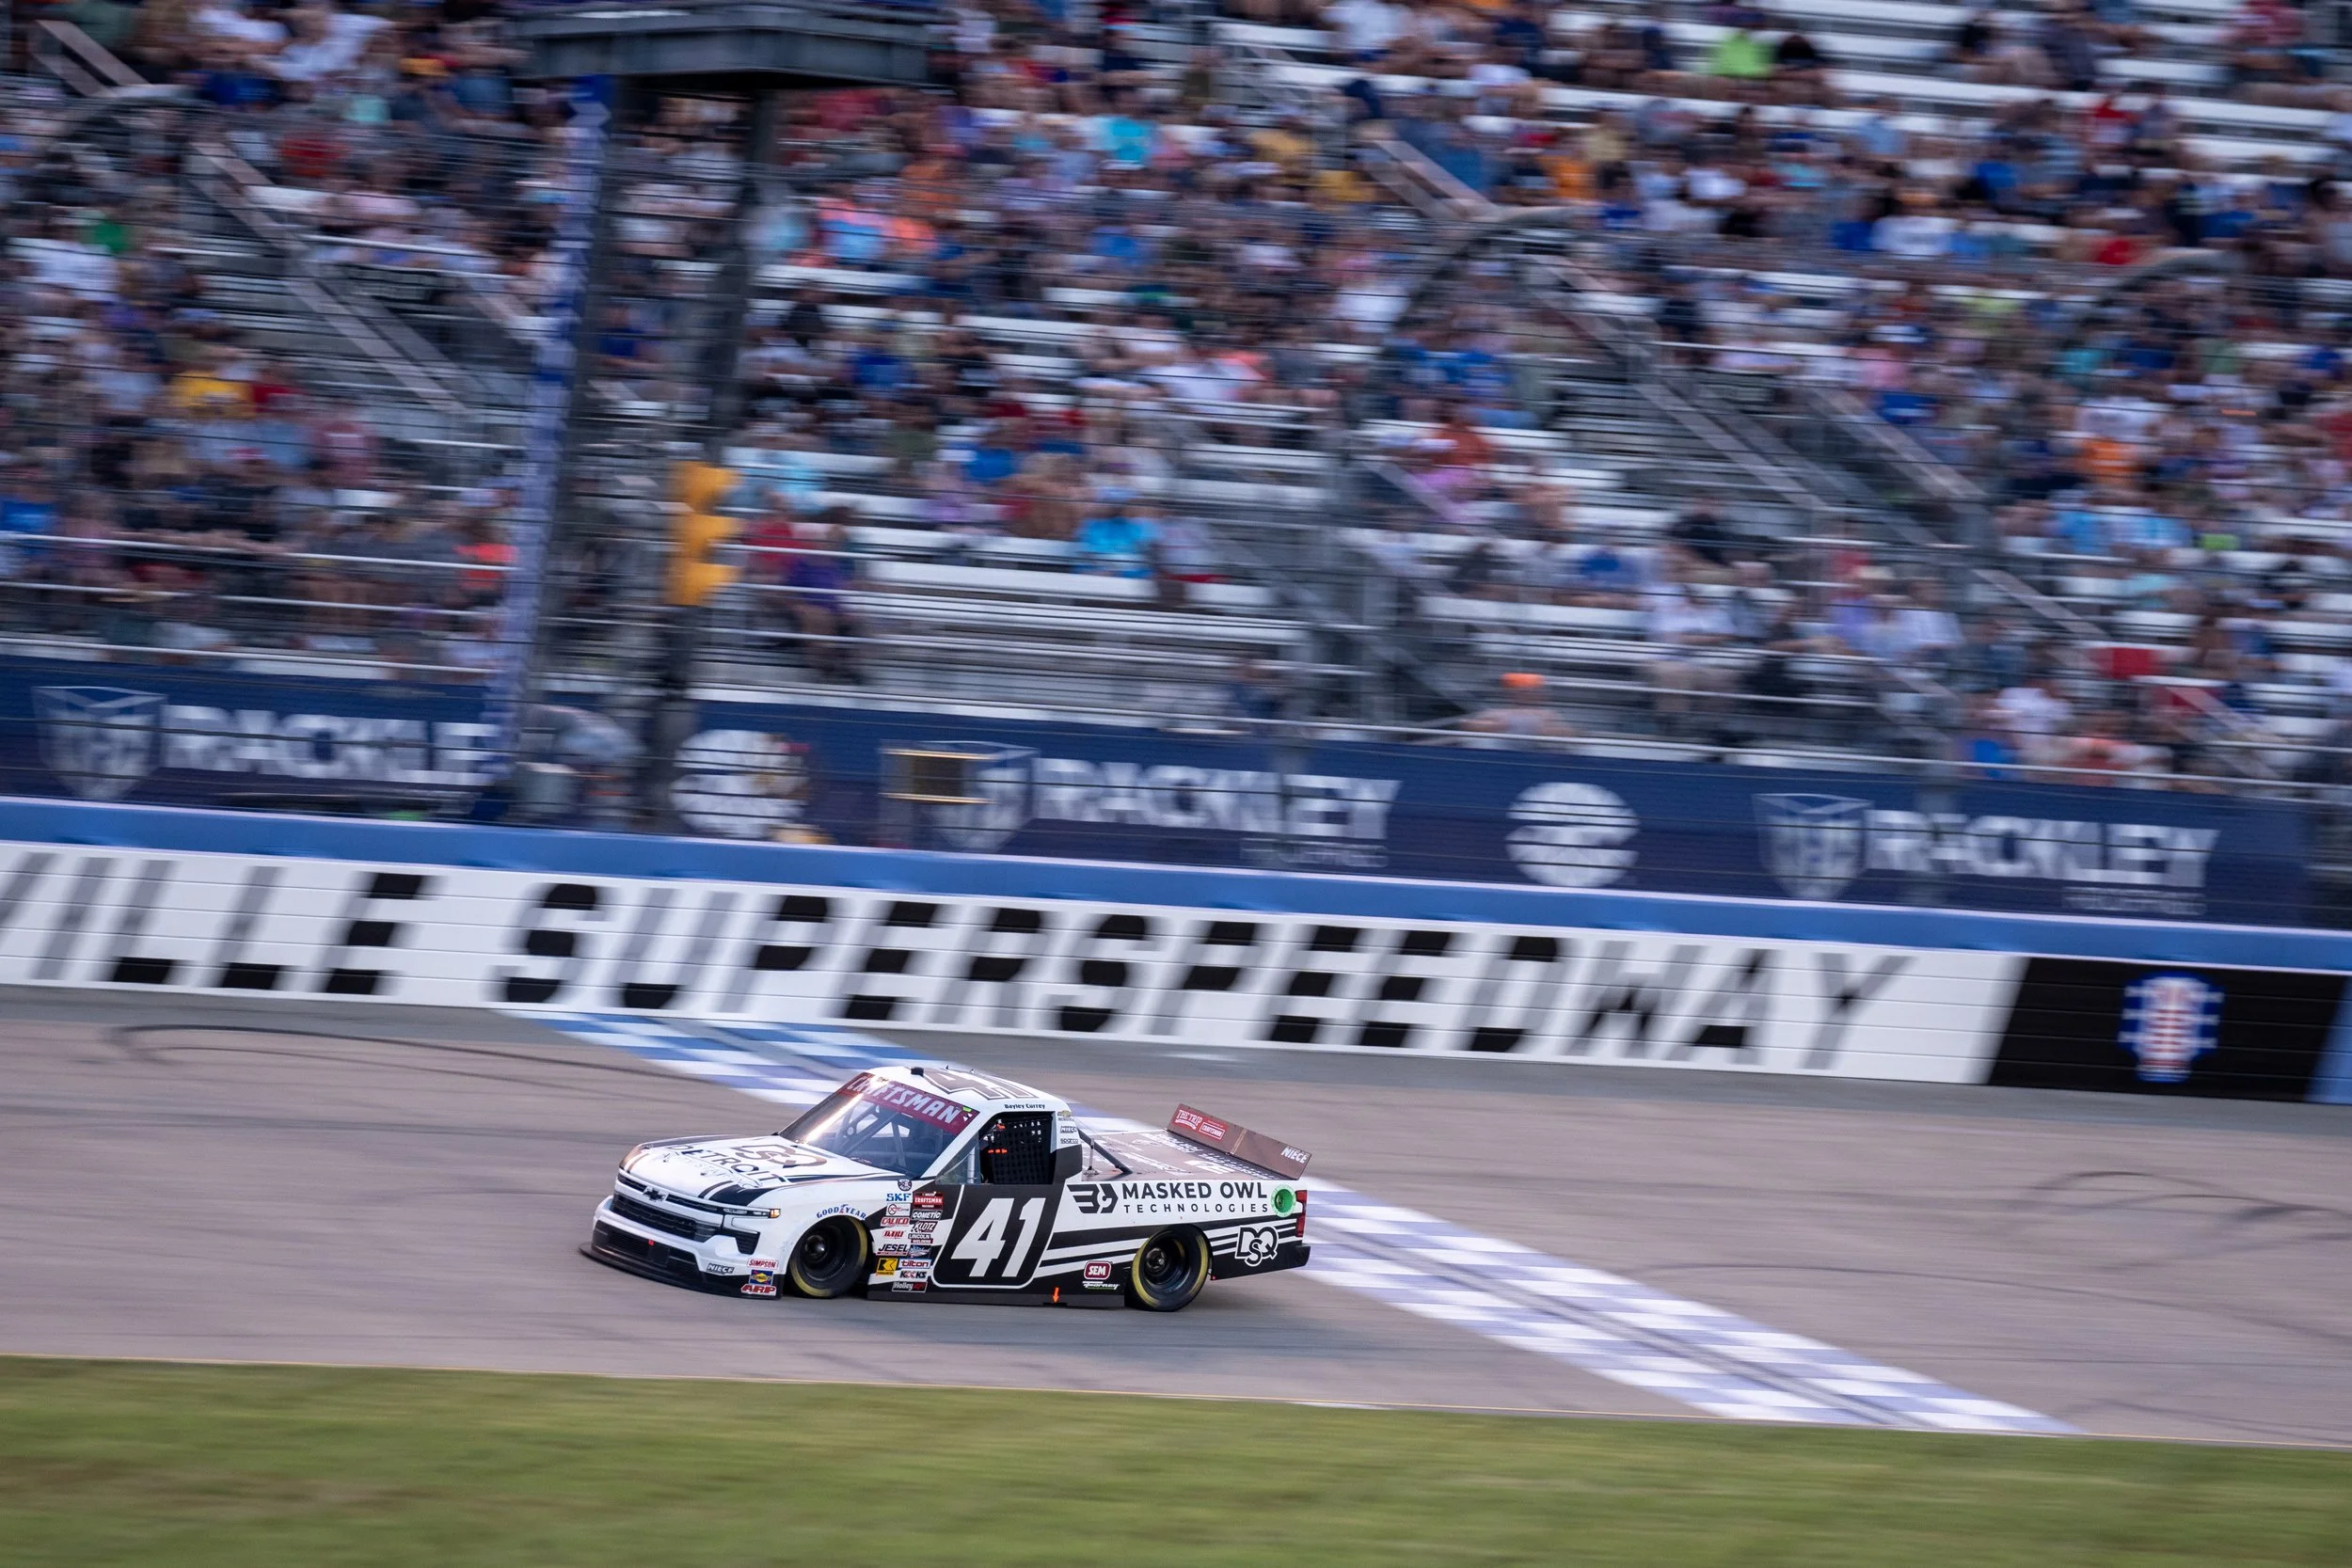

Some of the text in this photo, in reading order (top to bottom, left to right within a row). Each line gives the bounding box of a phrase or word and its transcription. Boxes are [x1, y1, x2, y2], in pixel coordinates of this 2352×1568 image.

[1037, 756, 1400, 840] RACKLEY
[1867, 808, 2220, 888] RACKLEY
[487, 882, 1914, 1070] SUPERSPEEDWAY
[847, 1072, 961, 1123] CRAFTSMAN
[1176, 1109, 1190, 1120] THE
[1188, 1113, 1203, 1126] TRIP
[665, 1145, 786, 1183] DETROIT
[1280, 1147, 1309, 1164] NIECE
[886, 1193, 911, 1201] SKF
[1122, 1182, 1267, 1199] MASKED OWL
[1124, 1203, 1268, 1213] TECHNOLOGIES
[951, 1197, 1046, 1277] 41
[749, 1259, 776, 1268] SIMPSON
[1088, 1266, 1106, 1275] SEM
[741, 1284, 776, 1294] ARP
[894, 1282, 914, 1291] Holley
